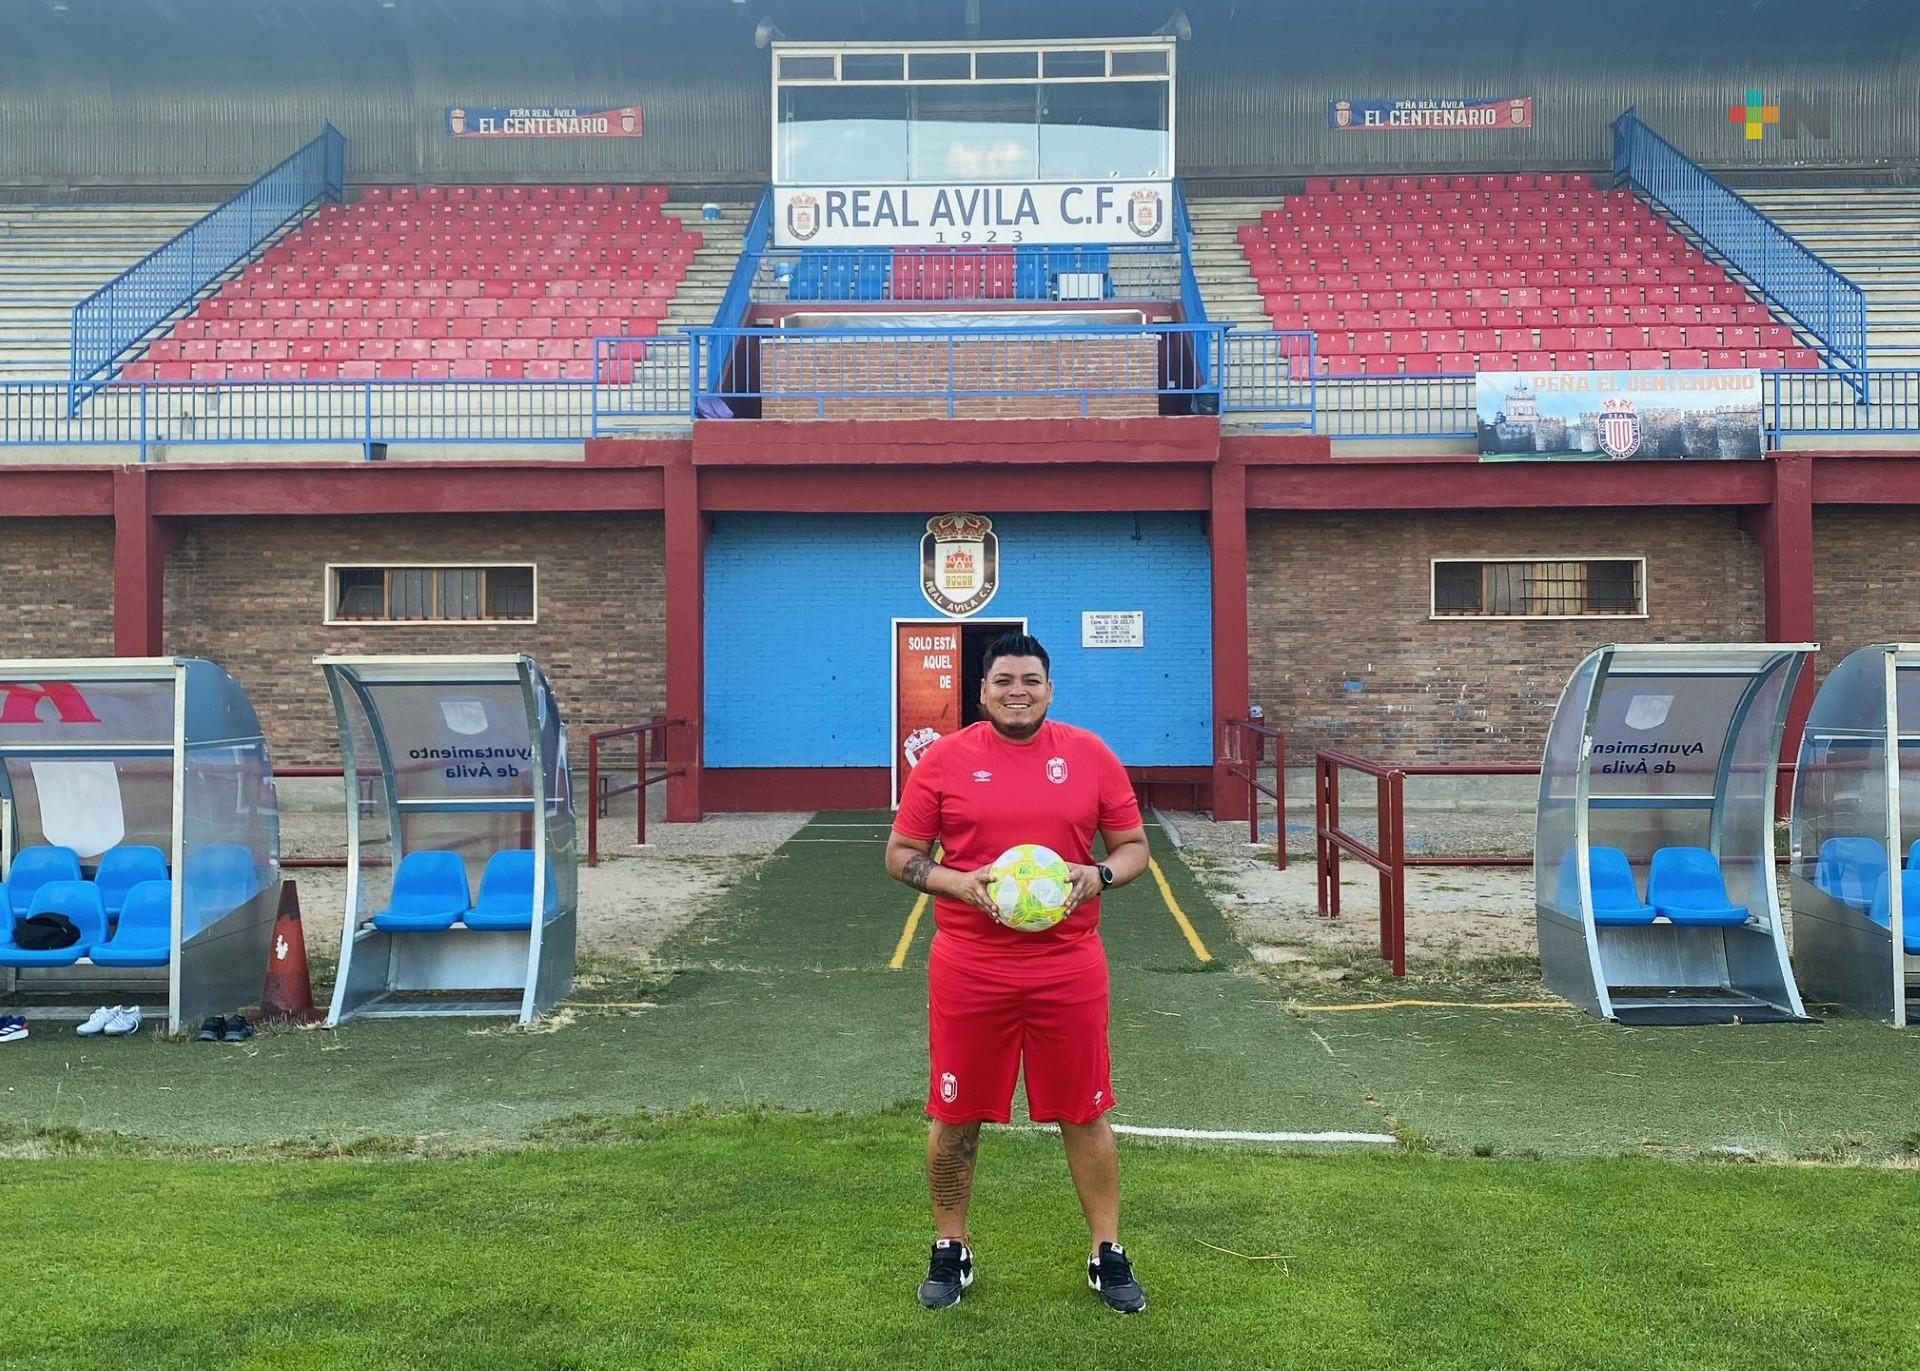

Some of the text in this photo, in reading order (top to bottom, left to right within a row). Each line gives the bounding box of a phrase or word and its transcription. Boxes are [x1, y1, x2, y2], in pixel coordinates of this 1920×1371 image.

[509, 107, 576, 117] PEÑA REAL ÁVILA
[1395, 99, 1464, 109] PEÑA REAL ÁVILA
[1364, 109, 1496, 126] EL CENTENARIO
[479, 118, 608, 134] EL CENTENARIO
[826, 186, 1122, 227] REAL AVILA C.F.
[1535, 374, 1755, 393] PEÑA EL CENTENARIO
[925, 580, 942, 604] REAL
[946, 600, 979, 612] AVILA
[908, 633, 957, 651] SOLO ESTÁ
[922, 655, 952, 669] AQUEL
[939, 675, 952, 688] DE
